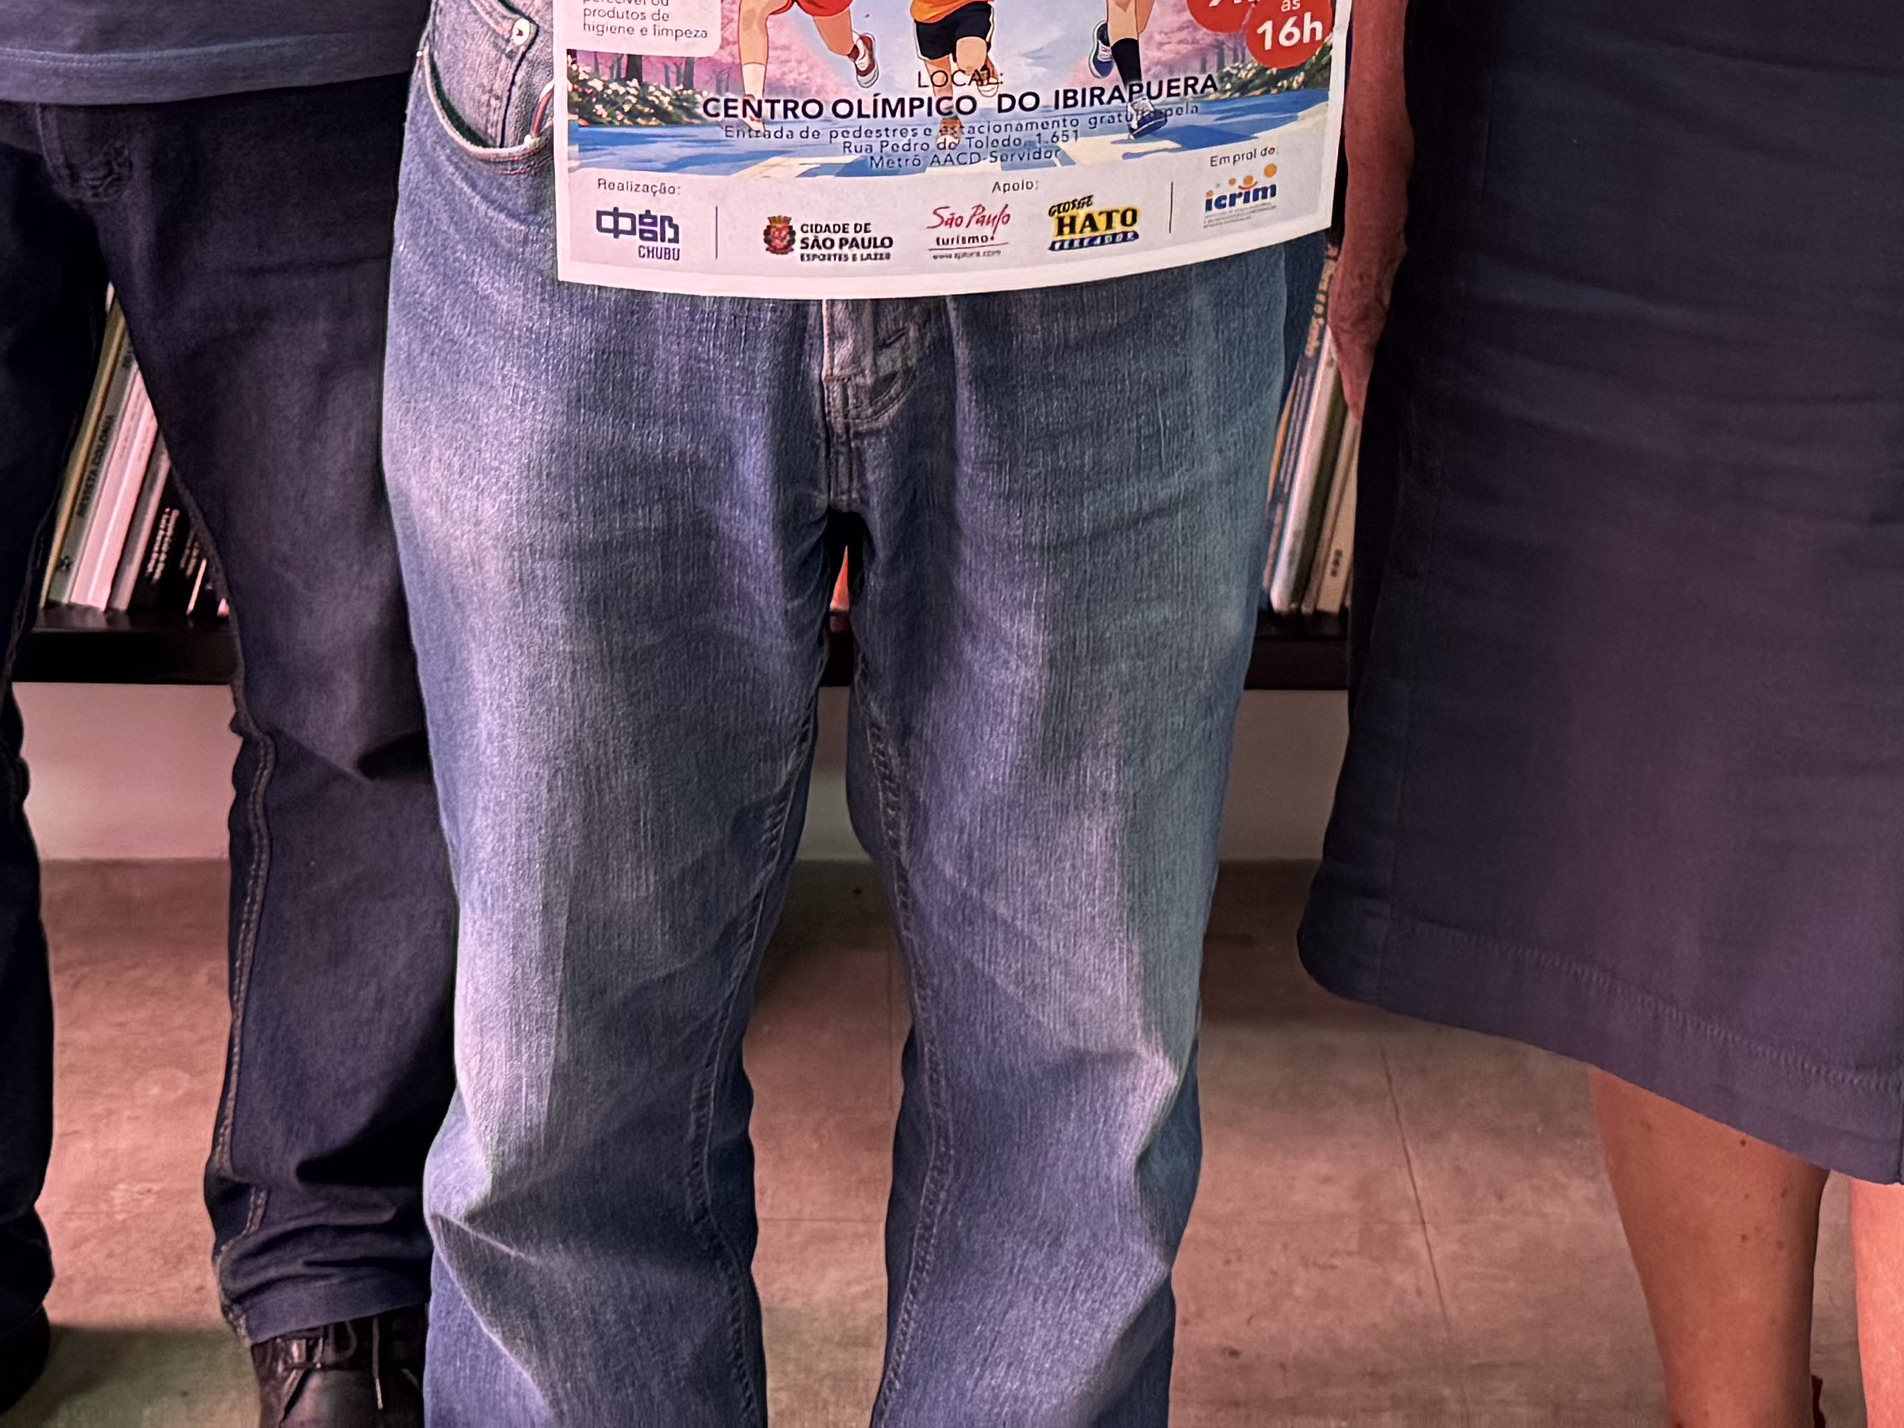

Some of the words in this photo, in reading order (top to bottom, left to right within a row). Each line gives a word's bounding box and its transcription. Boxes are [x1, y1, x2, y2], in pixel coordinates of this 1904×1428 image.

[584, 7, 646, 21] produtos
[651, 9, 669, 21] de
[583, 21, 634, 36] higiene
[640, 27, 648, 36] e
[653, 24, 708, 41] limpeza
[1257, 11, 1324, 50] 16h
[917, 69, 1004, 90] LOCAL:
[702, 96, 825, 121] CENTRO
[831, 91, 978, 119] OLÍMPICO
[997, 91, 1041, 114] DO
[1053, 73, 1219, 111] IBIRAPUERA
[724, 124, 796, 141] Entrada
[799, 126, 822, 141] de
[828, 124, 919, 142] pedestres
[842, 141, 875, 155] Rua
[879, 139, 931, 154] Pedro
[597, 178, 681, 196] Realização:
[800, 222, 850, 235] CIDADE
[853, 222, 872, 234] DE
[1055, 206, 1139, 237] HATO
[800, 235, 835, 251] SÃO
[838, 236, 894, 250] PAULO
[638, 245, 681, 261] CHUBU
[800, 252, 849, 262] ESPORTES
